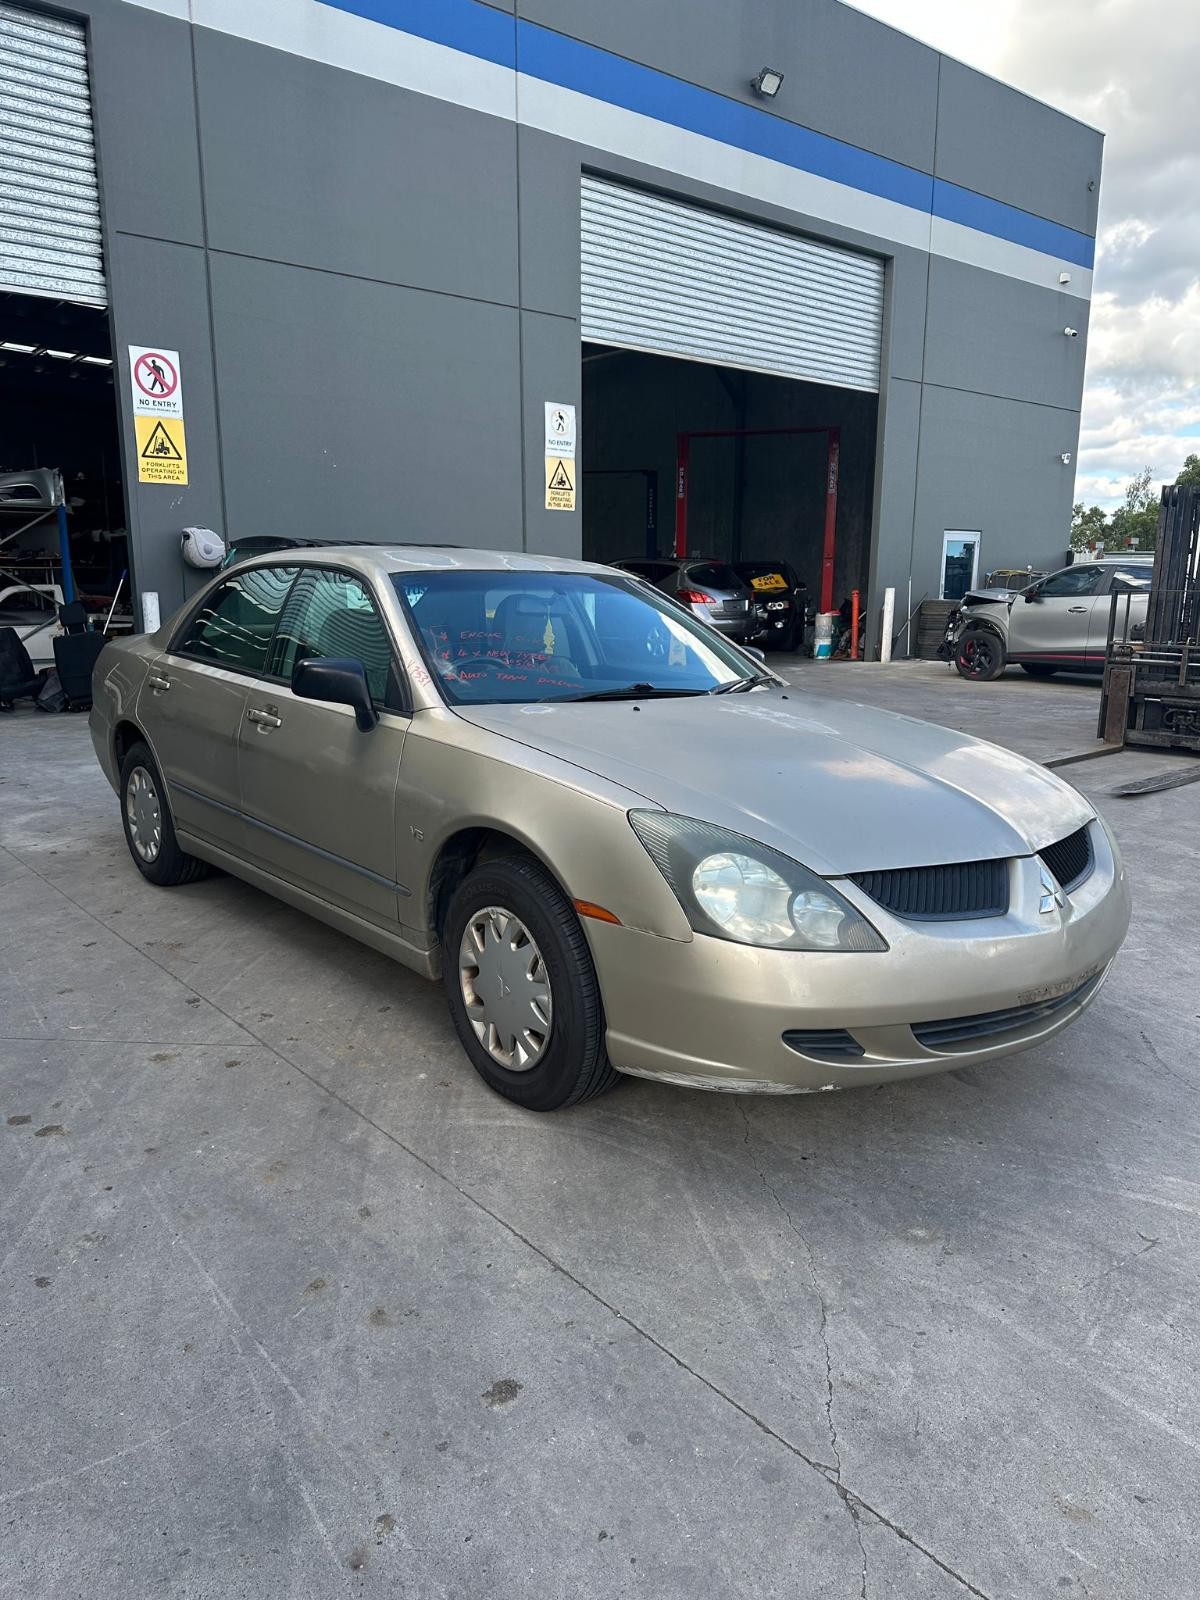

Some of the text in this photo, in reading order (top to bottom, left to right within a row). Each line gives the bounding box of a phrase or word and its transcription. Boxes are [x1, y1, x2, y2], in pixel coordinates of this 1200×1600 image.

[152, 400, 177, 408] ENTRY
[146, 461, 180, 469] FORKLIFTS
[141, 467, 177, 475] OPERATING
[758, 575, 775, 583] FOR
[460, 631, 504, 641] ENGINE
[457, 649, 467, 657] 4
[487, 649, 511, 658] NEW
[409, 825, 424, 840] V6
